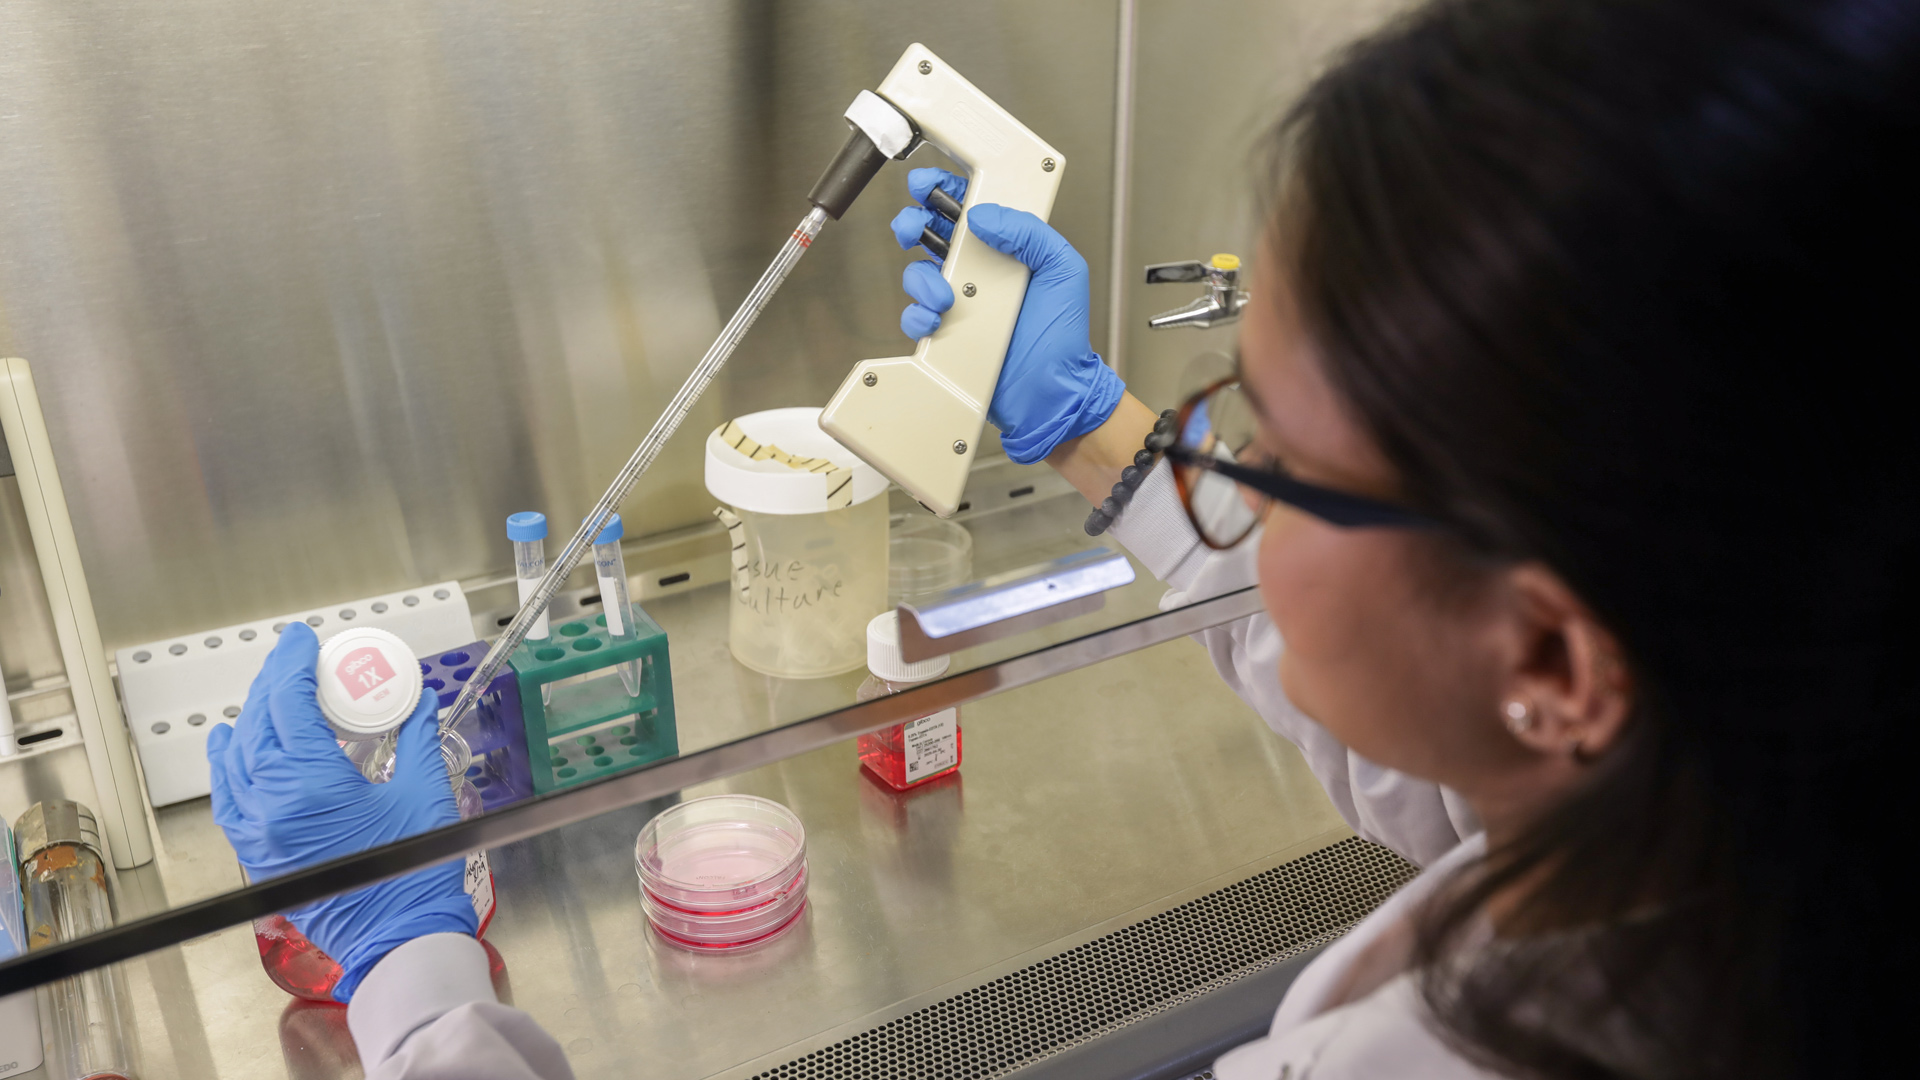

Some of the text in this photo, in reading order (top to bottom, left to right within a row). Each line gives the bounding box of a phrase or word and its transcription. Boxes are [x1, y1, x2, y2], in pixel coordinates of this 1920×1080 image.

[344, 653, 373, 676] gibco
[358, 666, 385, 689] 1X
[917, 717, 931, 726] gibco
